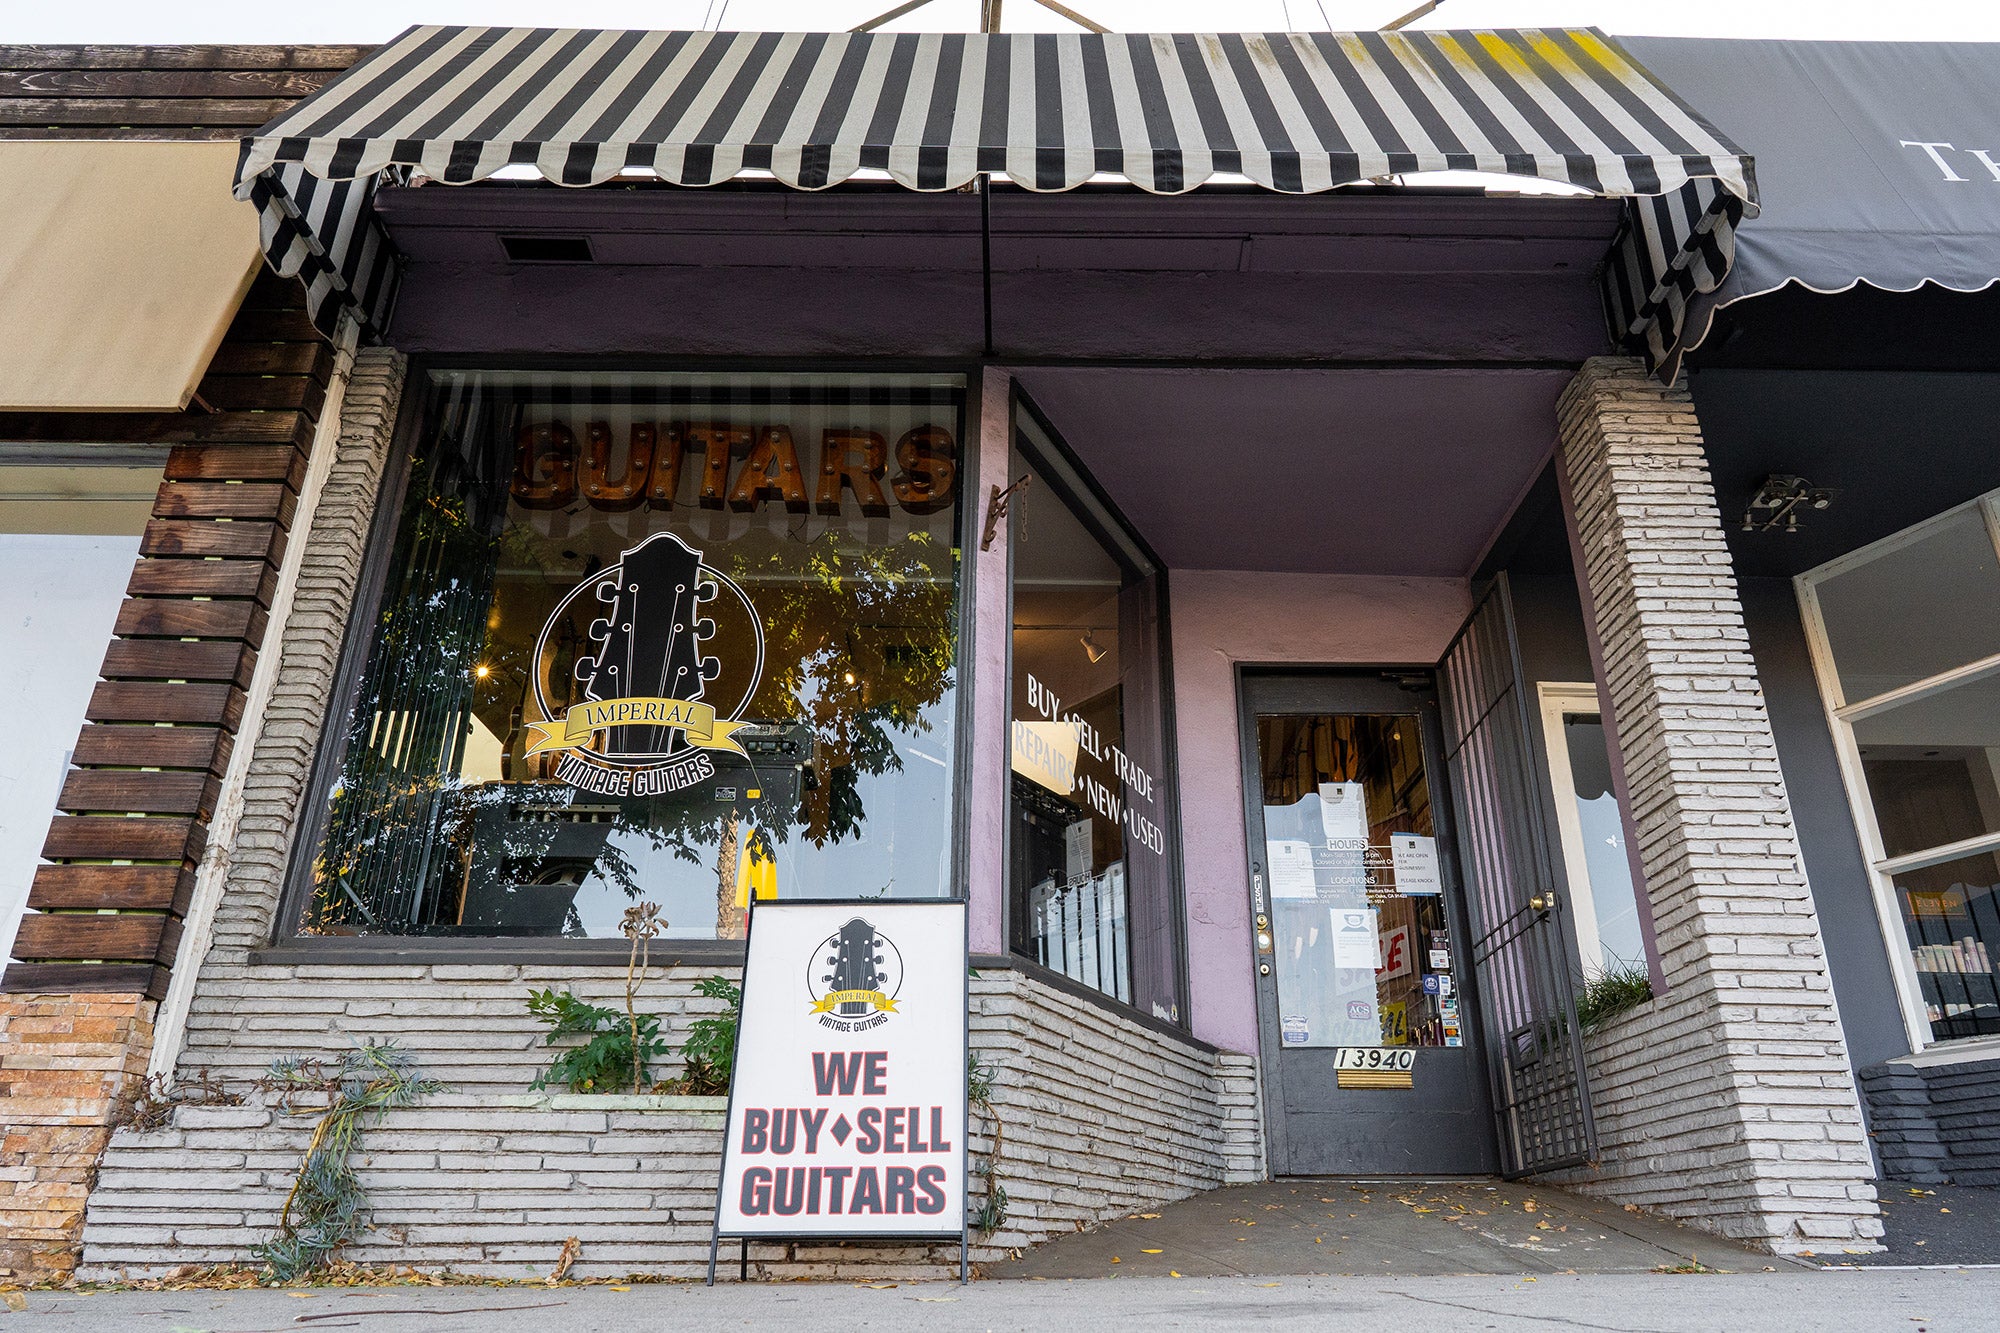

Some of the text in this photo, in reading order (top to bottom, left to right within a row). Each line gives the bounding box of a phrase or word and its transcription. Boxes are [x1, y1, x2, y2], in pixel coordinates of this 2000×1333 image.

[509, 422, 957, 518] GUITARS
[585, 701, 697, 727] IMPERIAL
[1027, 673, 1154, 804] BUY SELL TRADE
[555, 753, 716, 797] VINTAGE GUITARS
[1015, 718, 1076, 793] REPAIRS
[1086, 774, 1121, 825] NEW
[1130, 807, 1165, 856] USED
[1329, 840, 1366, 849] HOURS
[1254, 875, 1262, 905] PUSH
[1330, 876, 1376, 884] LOCATIONS
[831, 990, 879, 1003] IMPERIAL
[1349, 1005, 1370, 1014] ACS
[818, 1013, 889, 1032] VINTAGE GUITARS
[811, 1051, 889, 1096] WE
[1339, 1049, 1412, 1069] 13940
[741, 1106, 952, 1155] BUY SELL
[739, 1164, 948, 1217] GUITARS
